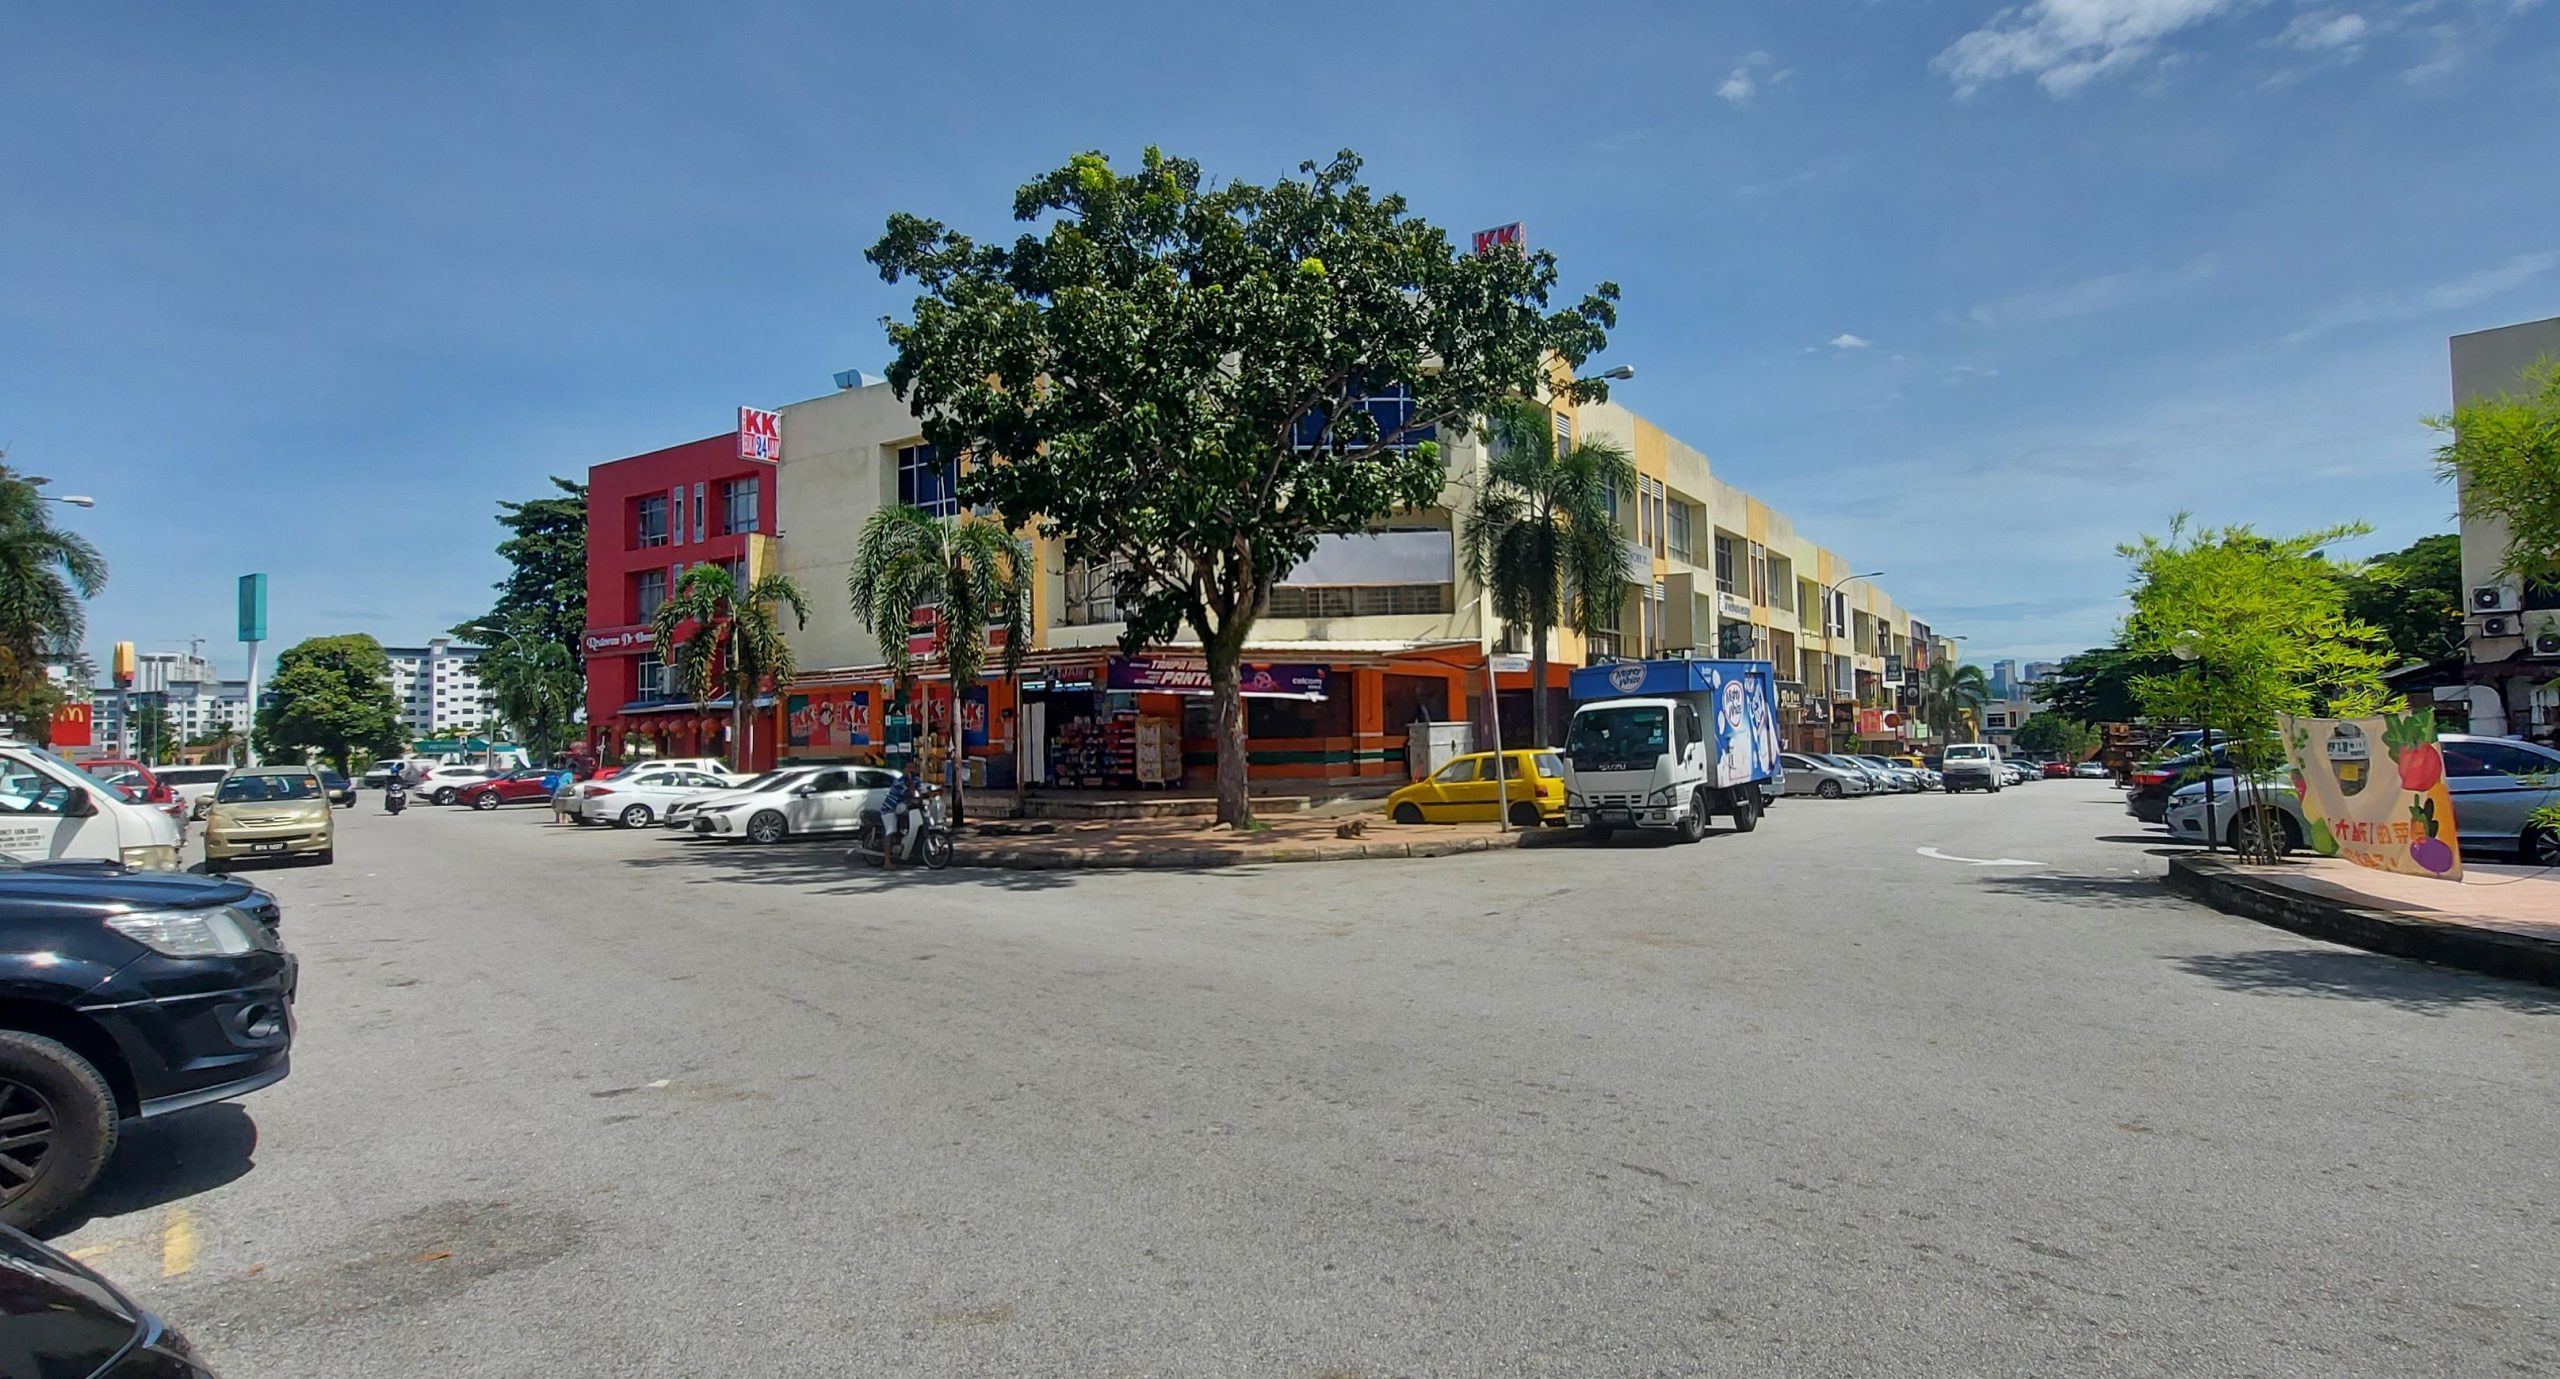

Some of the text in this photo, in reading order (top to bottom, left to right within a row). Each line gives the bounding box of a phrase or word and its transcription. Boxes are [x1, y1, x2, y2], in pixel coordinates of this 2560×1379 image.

[1477, 224, 1517, 258] KK
[745, 409, 777, 437] KK
[756, 436, 767, 458] 24
[1292, 677, 1323, 685] celcom
